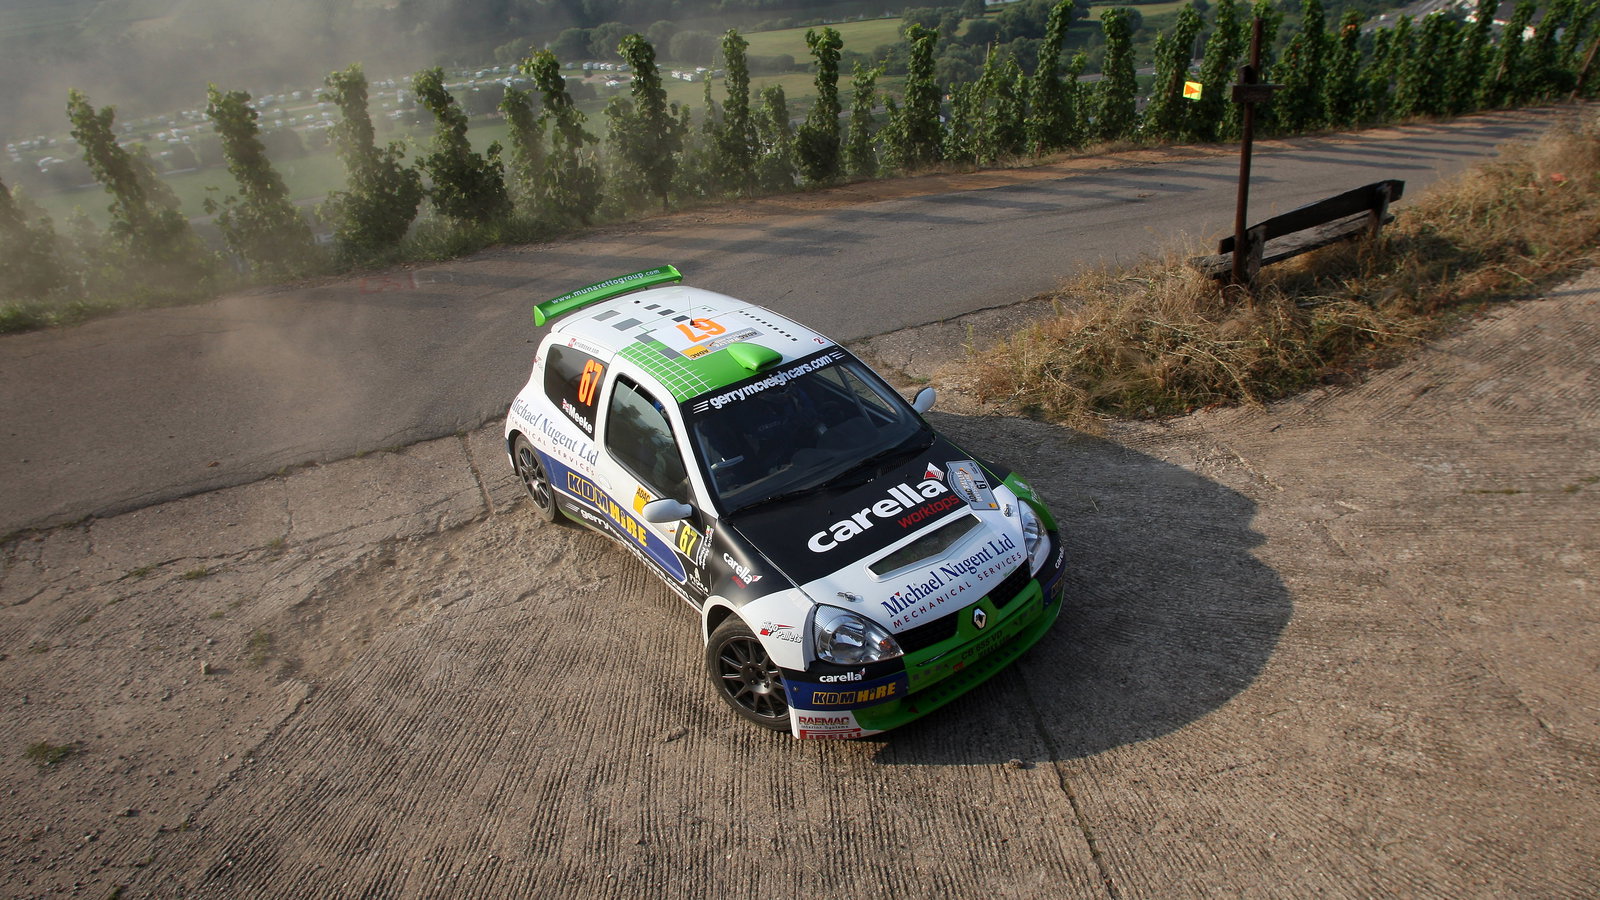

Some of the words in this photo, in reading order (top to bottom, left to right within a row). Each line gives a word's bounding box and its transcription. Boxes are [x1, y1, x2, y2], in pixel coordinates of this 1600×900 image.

[551, 268, 660, 304] www.munarettogroup.com
[675, 317, 727, 343] 67
[578, 359, 605, 406] 67
[709, 354, 833, 408] gerrymcveighcars.com
[568, 403, 593, 433] Meeke
[539, 417, 578, 453] Nugent
[578, 442, 600, 466] Ltd
[553, 446, 595, 476] SERVICES
[567, 471, 609, 513] KDM
[973, 479, 987, 490] 67
[807, 479, 949, 553] carella
[897, 494, 960, 529] worktops
[679, 525, 698, 557] 67
[723, 552, 753, 585] carella
[881, 570, 945, 618] Michael
[940, 547, 994, 582] Nugent
[989, 533, 1016, 556] Ltd
[893, 581, 972, 628] MECHANICAL
[977, 551, 1022, 581] SERVICES
[819, 671, 863, 683] carella
[812, 691, 856, 705] KDM
[798, 716, 850, 726] RAEMAC
